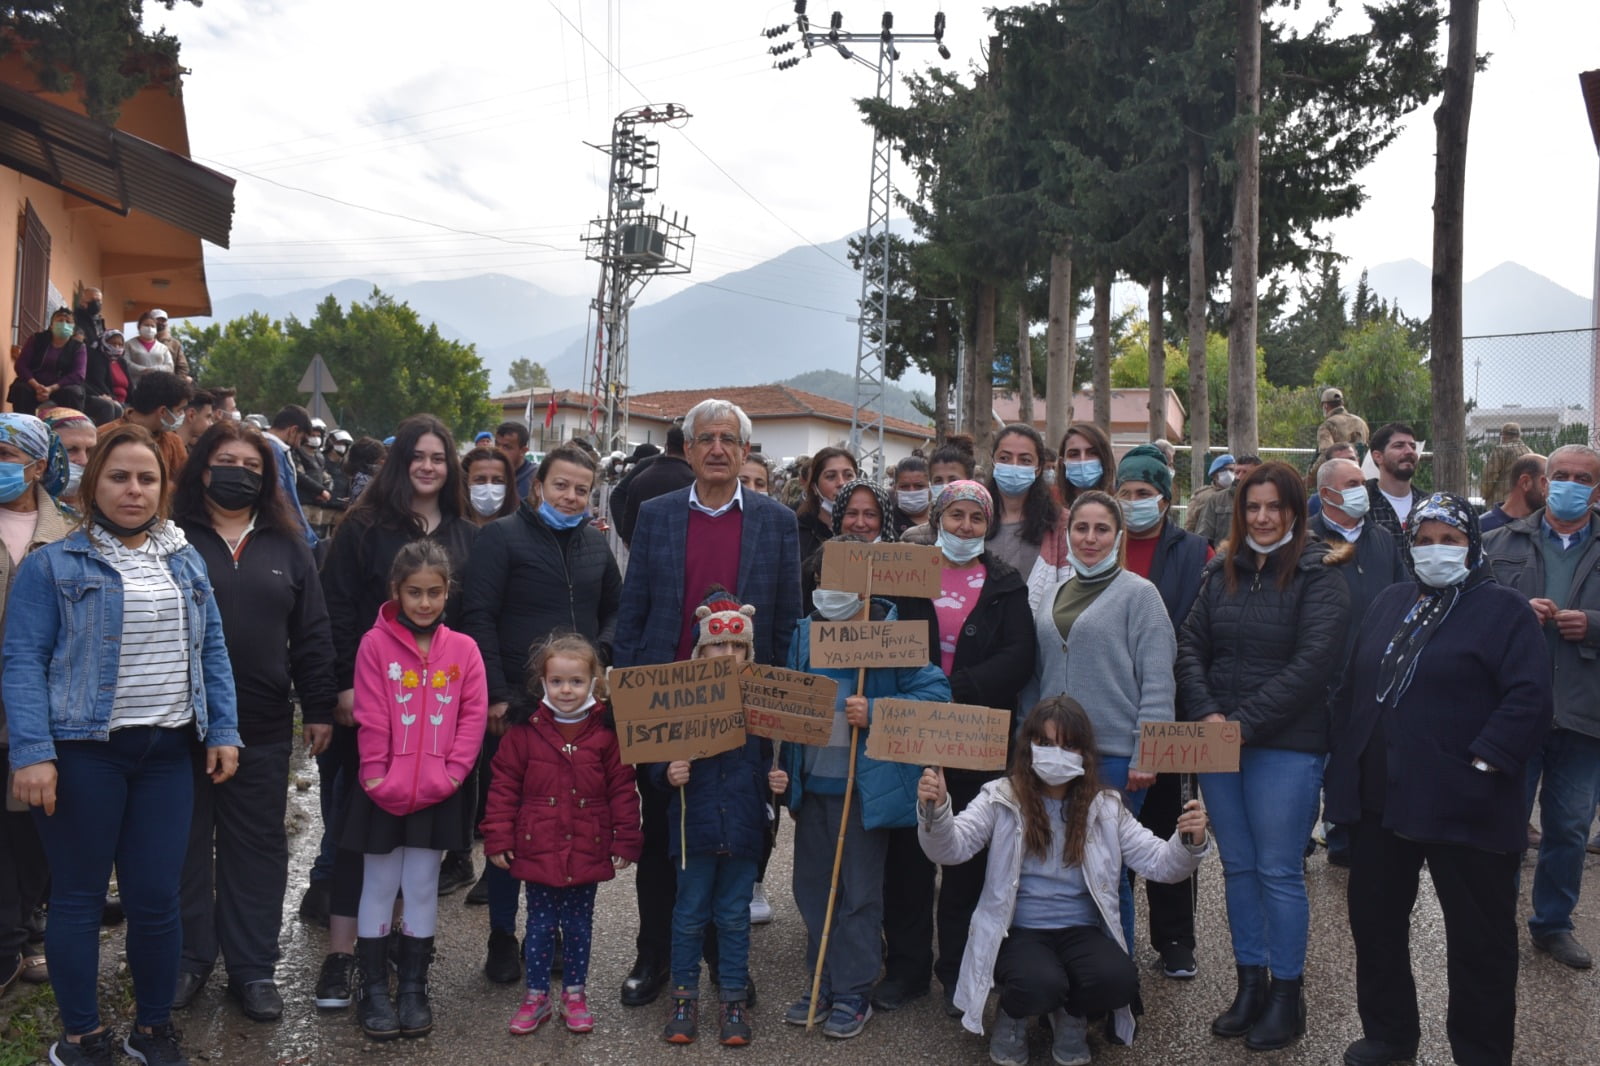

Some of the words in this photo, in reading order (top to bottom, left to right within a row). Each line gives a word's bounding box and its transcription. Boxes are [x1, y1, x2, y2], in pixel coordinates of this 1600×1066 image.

[819, 624, 893, 642] MADENE
[881, 634, 922, 648] HAYIR
[888, 648, 927, 658] EVET
[649, 681, 726, 710] MADEN
[879, 704, 917, 721] YAŞAM
[1143, 723, 1206, 738] MADENE
[1140, 739, 1213, 768] HAYIR
